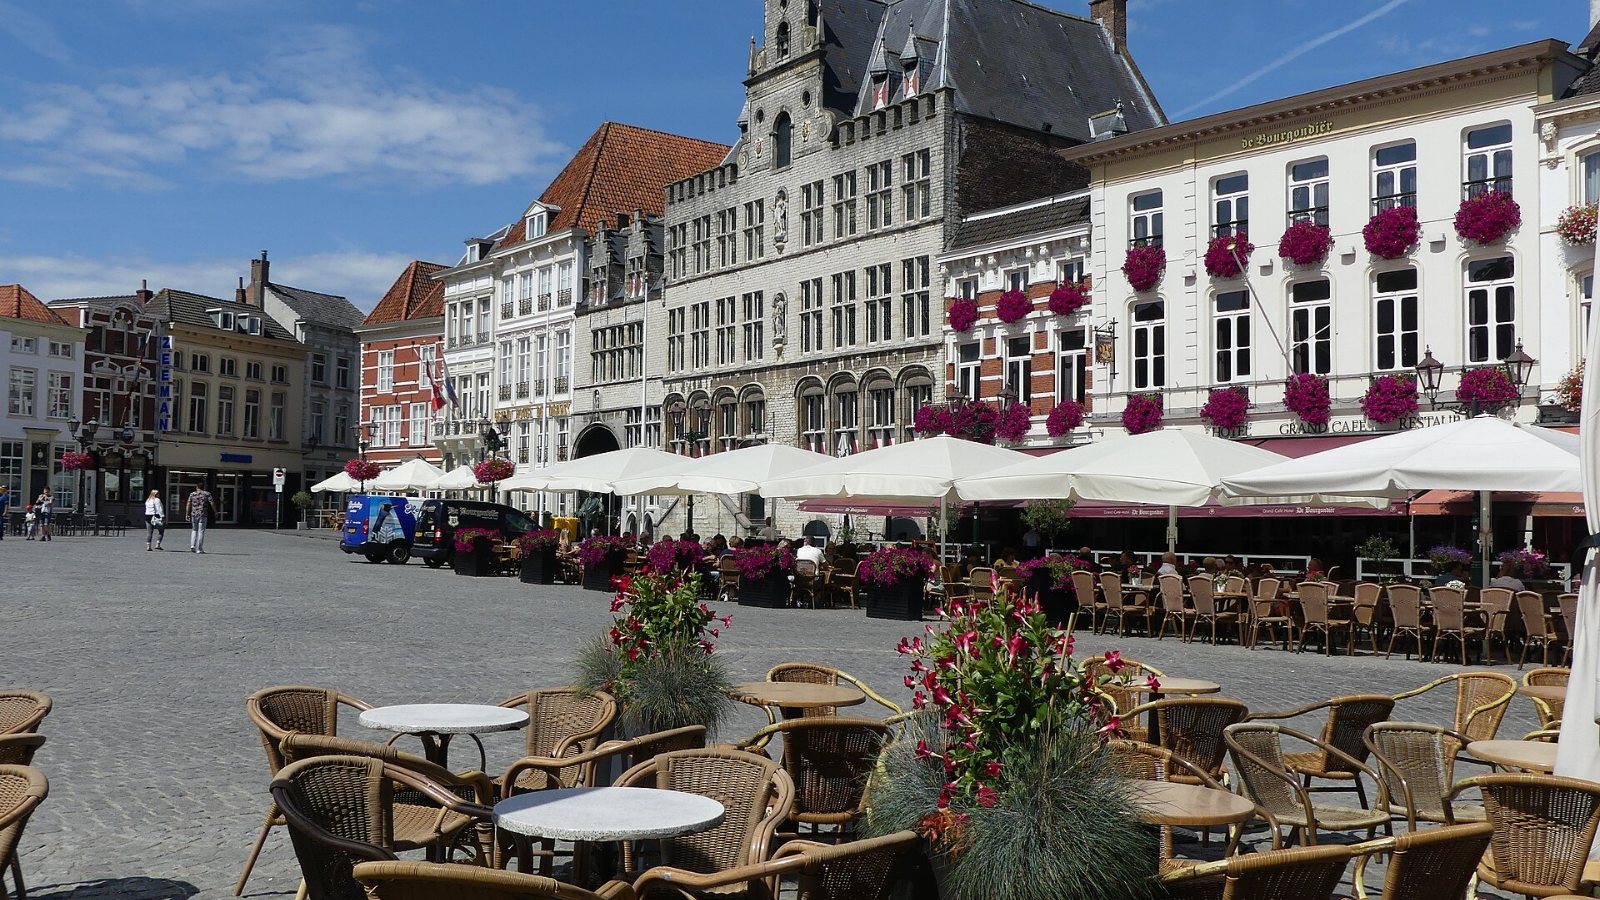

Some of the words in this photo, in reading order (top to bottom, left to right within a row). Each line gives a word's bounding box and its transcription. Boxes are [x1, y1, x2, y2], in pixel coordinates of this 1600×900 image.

[1241, 138, 1254, 149] de
[1256, 120, 1333, 146] Bourgondiër
[160, 336, 171, 431] ZEEMAN
[1212, 425, 1248, 438] HOTEL
[1279, 422, 1328, 435] GRAND
